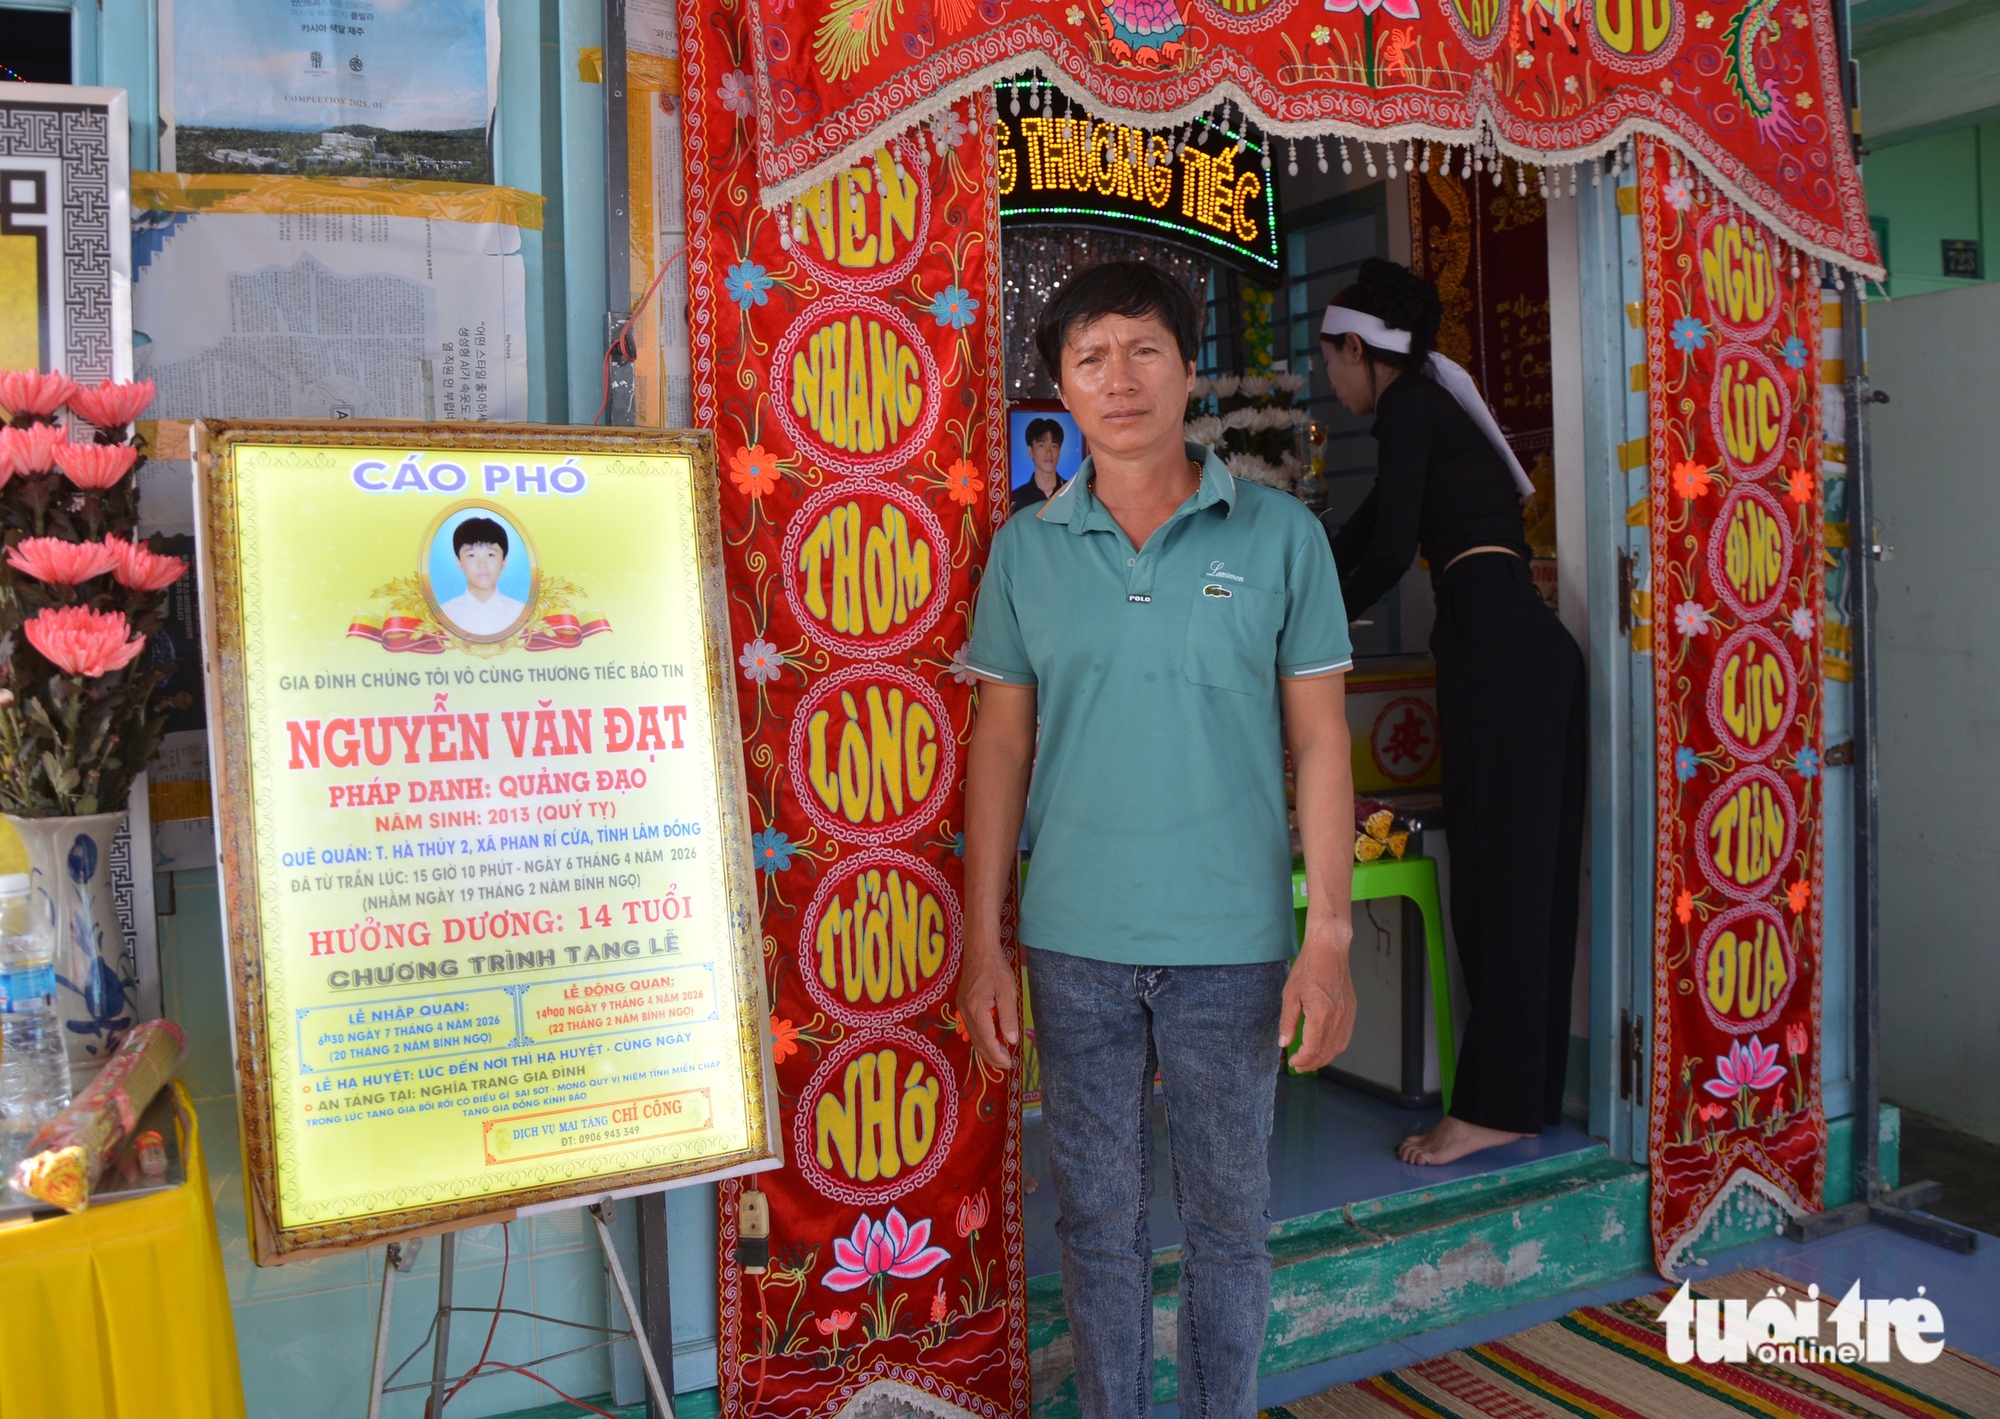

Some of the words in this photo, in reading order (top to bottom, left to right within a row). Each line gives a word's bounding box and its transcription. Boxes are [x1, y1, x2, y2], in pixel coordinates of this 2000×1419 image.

[302, 24, 326, 32] 카시아
[348, 26, 365, 36] 제주
[284, 94, 346, 105] COMPLETION
[442, 342, 454, 351] 열
[458, 327, 470, 357] 생성형
[443, 355, 454, 375] 직원
[443, 378, 454, 389] 안
[475, 349, 486, 380] 스타일
[460, 383, 471, 414] 속옷도
[791, 315, 923, 454] NHANG
[353, 454, 466, 492] CÁO
[484, 458, 586, 493] PHÓ
[800, 501, 931, 636] THƠM
[280, 676, 309, 690] GIA
[315, 670, 356, 689] ĐÌNH
[362, 668, 421, 687] CHÚNG
[426, 667, 449, 685] TÔI
[454, 666, 474, 684] VÔ
[479, 665, 524, 684] CÙNG
[528, 665, 590, 682] THƯƠNG
[594, 660, 626, 679] TIẾC
[631, 662, 658, 678] BÁO
[662, 664, 684, 678] TIN
[1722, 640, 1784, 746] LÚC
[286, 692, 490, 769] NGUYỄN
[501, 699, 592, 758] VĂN
[603, 705, 687, 763] ĐẠT
[808, 685, 937, 824] LÒNG
[329, 777, 401, 808] PHÁP
[408, 778, 491, 803] DANH:
[499, 767, 590, 798] QUẢNG
[596, 768, 647, 795] ĐẠO
[375, 812, 423, 832] NĂM
[429, 810, 481, 828] SINH:
[488, 807, 530, 824] 2013
[537, 799, 582, 824] (QUÝ
[588, 801, 616, 820] TỴ)
[282, 847, 316, 867] QUÊ
[322, 844, 372, 864] QUÁN:
[376, 846, 388, 860] T.
[393, 840, 414, 858] HÀ
[418, 837, 456, 856] THỦY
[461, 840, 473, 855] 2,
[477, 836, 496, 852] XÃ
[500, 834, 539, 850] PHAN
[544, 829, 556, 847] RÍ
[561, 827, 593, 845] CỬA,
[633, 822, 659, 840] LÂM
[663, 818, 701, 837] ĐỒNG
[291, 876, 311, 892] ĐÃ
[315, 872, 333, 890] TỪ
[337, 870, 374, 888] TRẦN
[379, 868, 408, 885] LÚC:
[413, 870, 428, 883] 15
[432, 863, 457, 880] GIỜ
[462, 865, 475, 879] 10
[480, 858, 513, 877] PHÚT
[524, 856, 562, 874] NGÀY
[566, 858, 573, 870] 6
[576, 851, 620, 869] THÁNG
[624, 852, 631, 865] 4
[635, 848, 663, 864] NĂM
[670, 847, 697, 861] 2026
[362, 889, 410, 912] (NHẰM
[415, 887, 455, 906] NGÀY
[460, 888, 474, 901] 19
[478, 882, 525, 899] THÁNG
[529, 883, 535, 895] 2
[540, 879, 570, 894] NĂM
[574, 874, 604, 891] BÍNH
[609, 874, 641, 890] NGỌ)
[308, 916, 432, 956] HƯỞNG
[442, 910, 564, 944] DƯƠNG:
[578, 904, 612, 930] 14
[622, 883, 693, 925] TUỔI
[816, 869, 945, 1003] TƯỞNG
[328, 959, 459, 989] CHƯƠNG
[468, 948, 555, 974] TRÌNH
[564, 939, 640, 964] TANG
[649, 929, 679, 954] LỄ
[1707, 918, 1787, 1019] ĐƯA
[536, 1006, 565, 1020] 14h00
[568, 1001, 598, 1015] NGÀY
[601, 1002, 606, 1012] 9
[610, 995, 644, 1010] THÁNG
[647, 996, 653, 1005] 4
[656, 991, 680, 1004] NĂM
[682, 990, 704, 1001] 2026
[564, 984, 579, 1000] LỄ
[584, 982, 626, 998] ĐỘNG
[630, 977, 674, 990] QUAN:
[318, 1032, 344, 1046] 6h30
[348, 1027, 381, 1043] NGÀY
[385, 1028, 390, 1038] 7
[394, 1022, 434, 1037] THÁNG
[437, 1022, 443, 1032] 4
[447, 1016, 472, 1030] NĂM
[476, 1016, 500, 1027] 2026
[348, 1008, 366, 1025] LỄ
[371, 1006, 414, 1022] NHẬP
[420, 1002, 470, 1016] QUAN:
[316, 1077, 332, 1092] LỄ
[337, 1078, 358, 1092] HẠ
[362, 1070, 414, 1086] HUYỆT:
[419, 1065, 444, 1079] LÚC
[449, 1060, 478, 1075] ĐẾN
[484, 1057, 508, 1070] NƠI
[511, 1052, 532, 1066] THÌ
[537, 1051, 556, 1064] HẠ
[560, 1043, 603, 1059] HUYỆT
[614, 1038, 652, 1053] CÙNG
[656, 1031, 692, 1046] NGÀY
[318, 1099, 339, 1112] AN
[344, 1093, 385, 1108] TÁNG
[390, 1089, 416, 1103] TẠI:
[420, 1080, 468, 1098] NGHĨA
[471, 1075, 519, 1090] TRANG
[523, 1069, 548, 1083] GIA
[552, 1065, 586, 1079] ĐÌNH
[513, 1126, 539, 1141] DỊCH
[542, 1123, 556, 1137] VỤ
[559, 1121, 578, 1132] MAI
[581, 1115, 608, 1129] TÁNG
[612, 1101, 639, 1124] CHÍ
[642, 1099, 682, 1117] CÔNG
[816, 1048, 940, 1182] NHỚ
[561, 1137, 577, 1147] ĐT:
[579, 1132, 602, 1143] 0906
[604, 1129, 622, 1140] 943
[623, 1126, 640, 1136] 349
